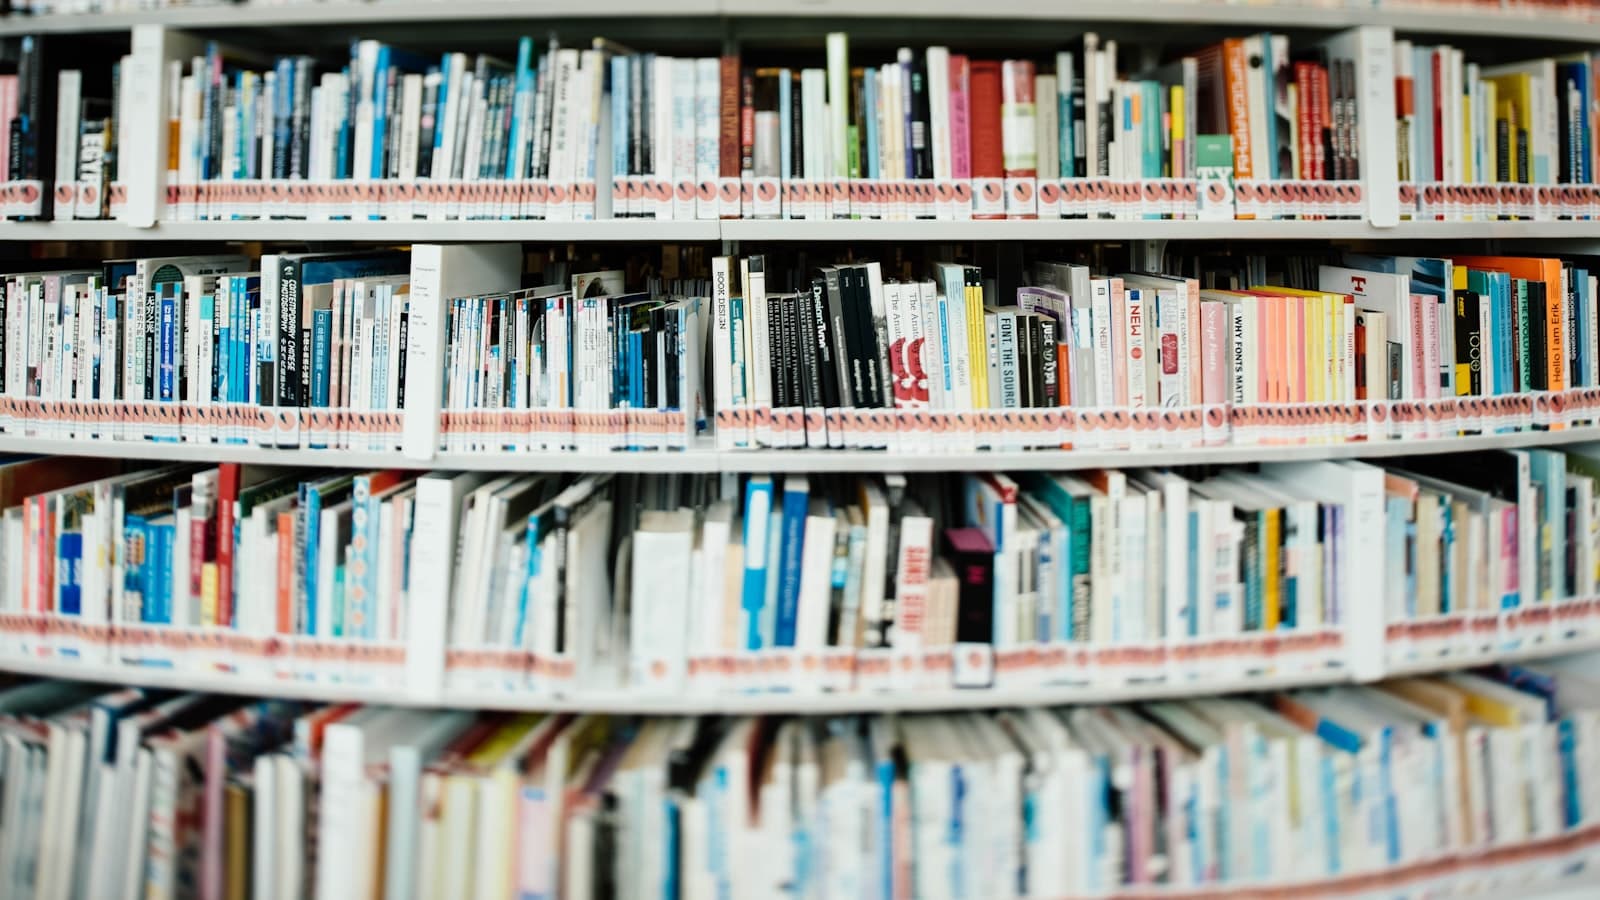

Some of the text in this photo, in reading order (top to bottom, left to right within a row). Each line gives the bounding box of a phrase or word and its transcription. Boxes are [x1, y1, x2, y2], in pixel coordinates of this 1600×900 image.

[280, 279, 288, 332] PHOTOGRAPHY
[717, 271, 727, 330] BOOK DESIGN
[798, 299, 807, 323] ROBERT
[804, 298, 812, 311] THE
[891, 292, 899, 310] The
[909, 292, 917, 311] The
[925, 294, 933, 308] The
[287, 279, 296, 371] CONTEMPORARY CHINESE
[783, 302, 791, 326] ROBERT
[1130, 305, 1141, 336] NEW
[1552, 303, 1560, 324] Erik
[773, 315, 781, 347] ELEMENTS
[789, 315, 797, 347] ELEMENTS
[806, 312, 815, 345] ELEMENTS
[892, 313, 903, 354] Anatomy
[910, 313, 921, 354] Anatomy
[926, 311, 937, 354] Geometry
[1001, 318, 1013, 345] FONT.
[1099, 326, 1107, 348] NEW
[1234, 316, 1242, 338] WHY
[1553, 328, 1559, 344] am
[775, 348, 782, 357] OF
[791, 349, 797, 357] OF
[809, 345, 816, 354] OF
[1206, 310, 1218, 372] Script Fonts
[1002, 348, 1013, 367] THE
[1553, 353, 1561, 382] Hello
[1524, 374, 1530, 387] OF
